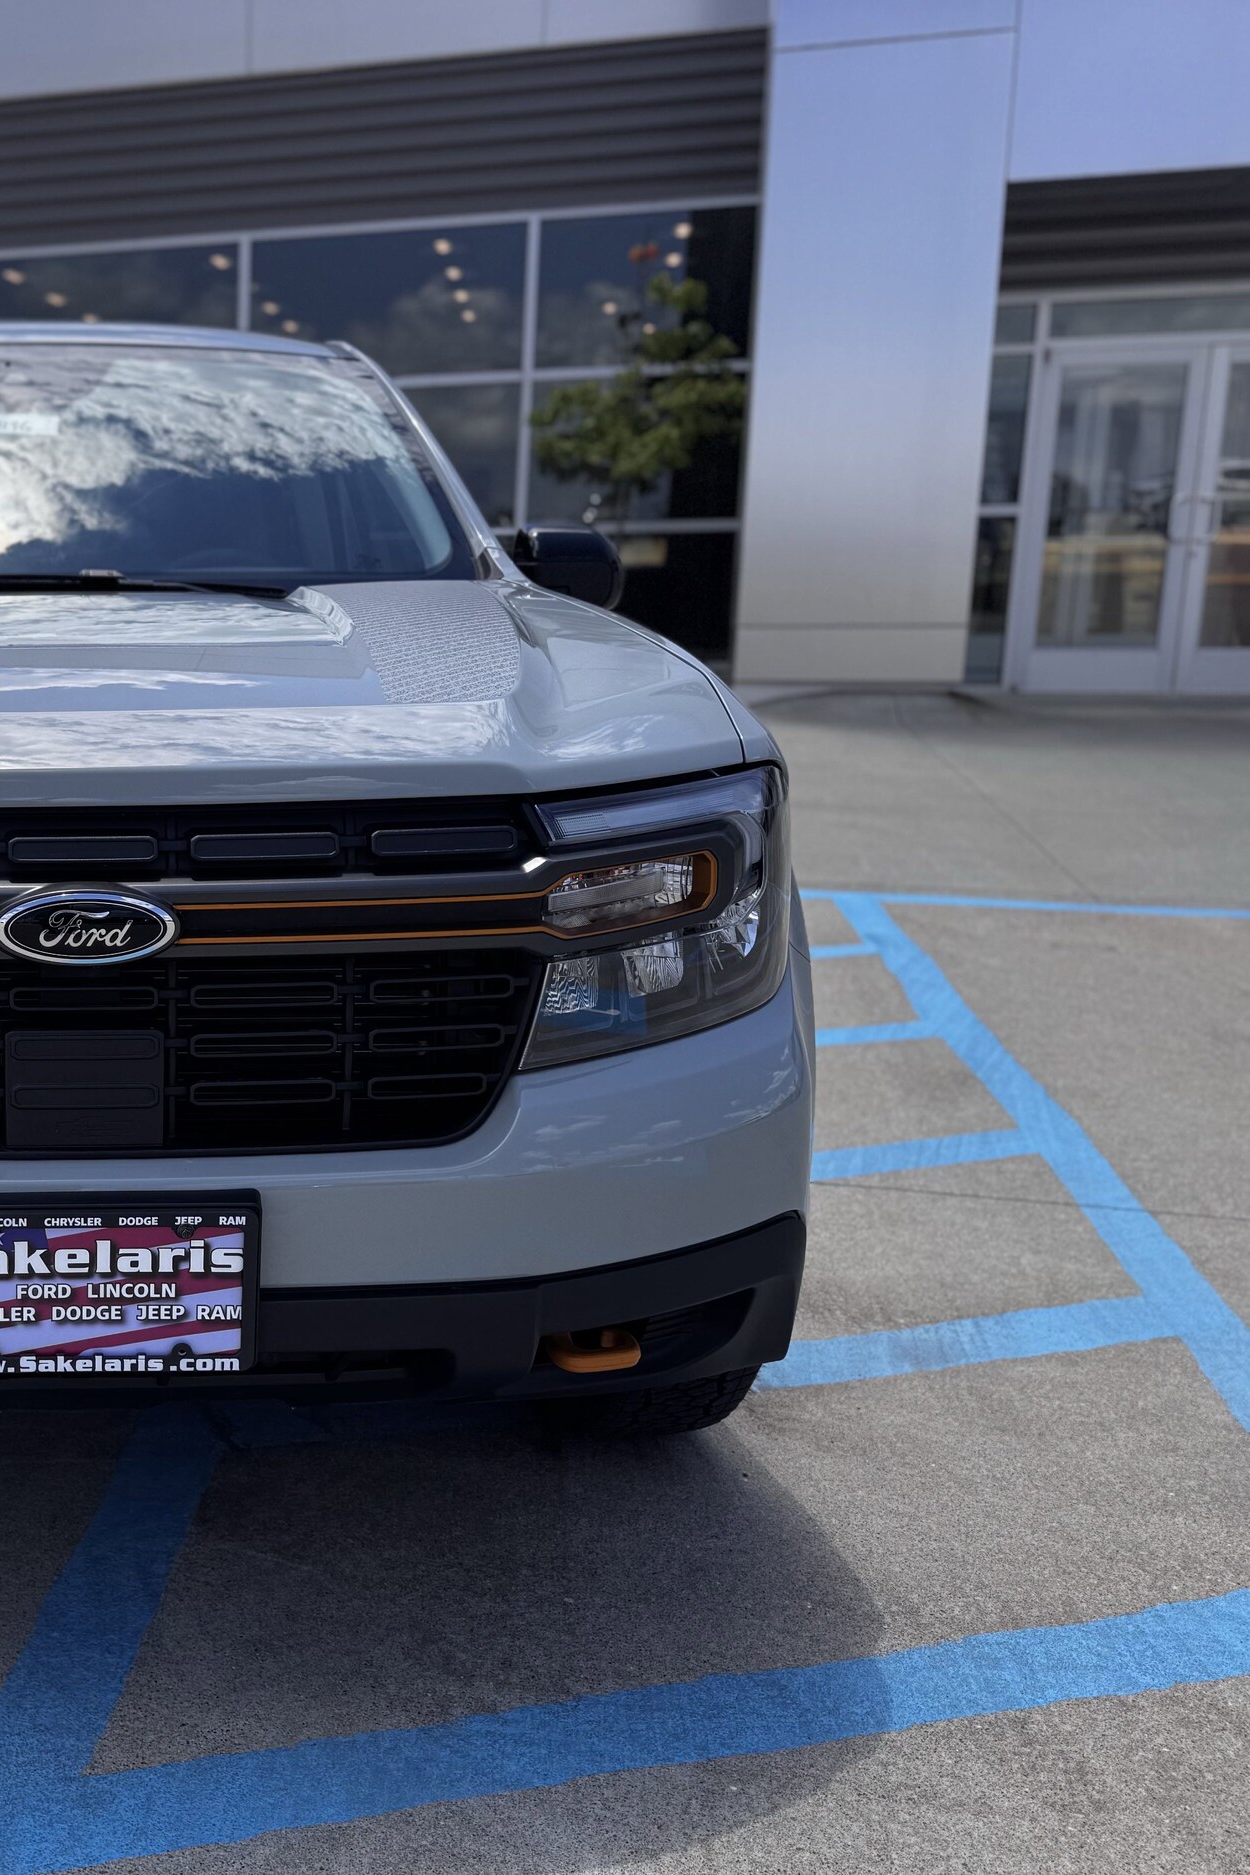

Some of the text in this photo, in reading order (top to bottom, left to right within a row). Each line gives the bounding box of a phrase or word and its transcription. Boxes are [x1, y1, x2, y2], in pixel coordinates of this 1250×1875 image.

[39, 909, 134, 948] Ford
[44, 1217, 102, 1228] CHRYSLER
[118, 1217, 159, 1226] DODGE
[174, 1216, 203, 1226] JEEP
[219, 1216, 246, 1226] RAM
[16, 1283, 176, 1300] FORD LINCOLN
[52, 1305, 122, 1322] DODGE
[137, 1305, 185, 1321] JEEP
[197, 1305, 242, 1321] RAM
